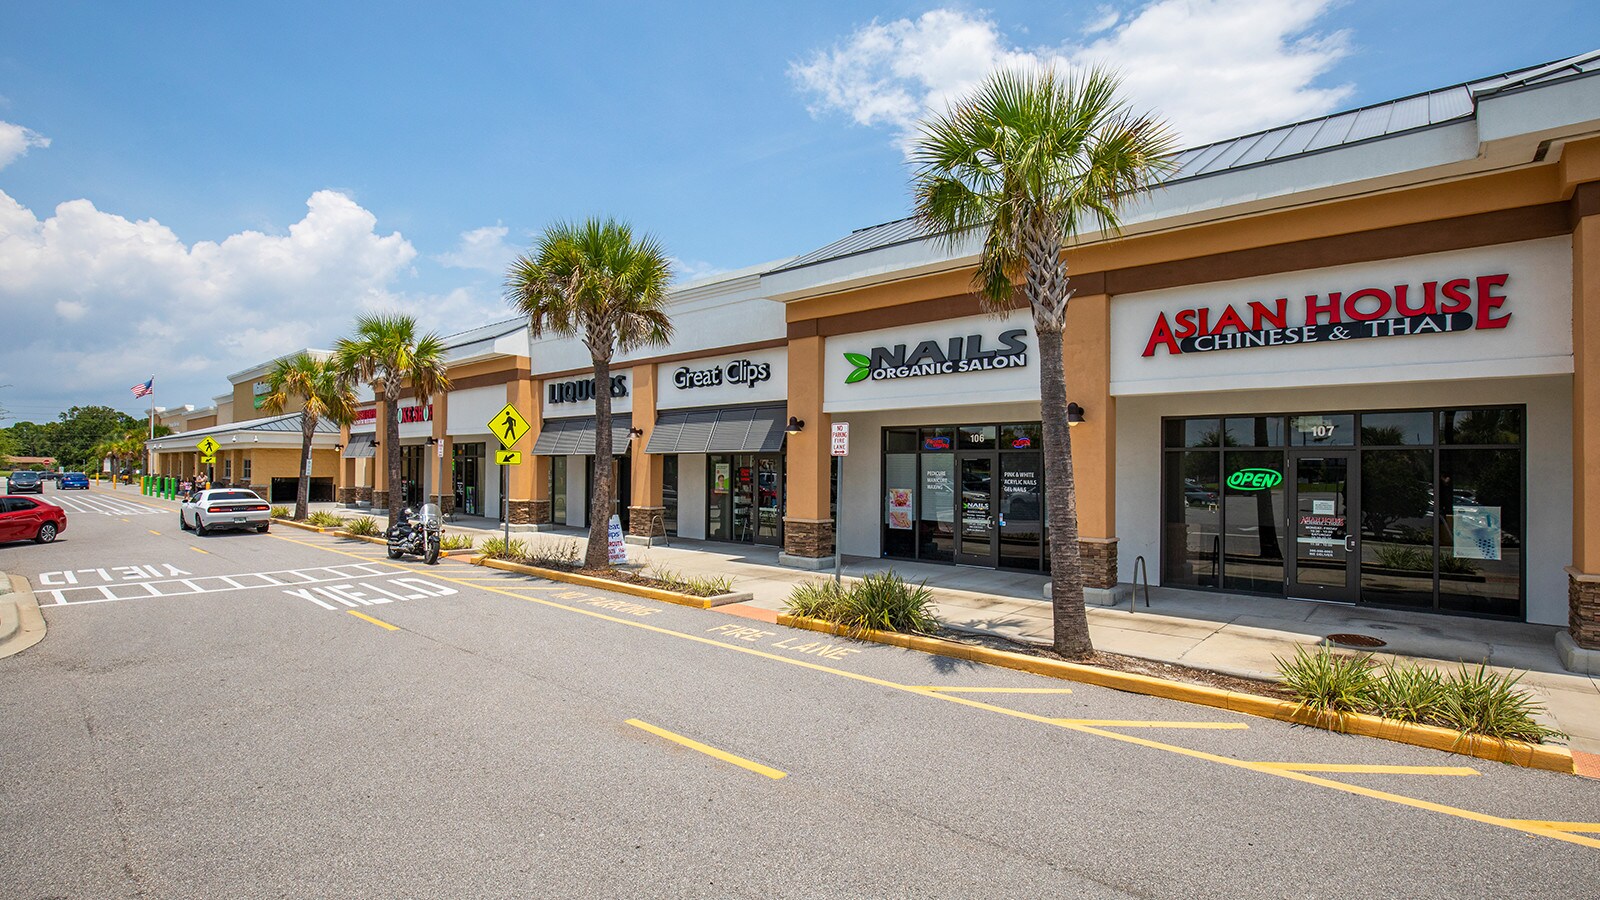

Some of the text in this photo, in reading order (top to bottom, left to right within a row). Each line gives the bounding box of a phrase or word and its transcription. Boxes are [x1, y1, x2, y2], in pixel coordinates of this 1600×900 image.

[1142, 274, 1512, 357] ASIAN HOUSE
[1194, 314, 1453, 351] CHINESE & THAI
[871, 329, 1027, 368] NAILS
[673, 359, 771, 390] Great Clips
[873, 354, 1025, 380] ORGANIC SALON
[970, 433, 985, 443] 106
[1311, 425, 1335, 437] 107
[1230, 471, 1277, 488] OPEN
[967, 502, 989, 510] NAILS
[39, 563, 192, 585] YIELD
[282, 578, 459, 610] YIELD
[576, 596, 662, 616] PARKING
[706, 623, 863, 660] FIRE LANE
